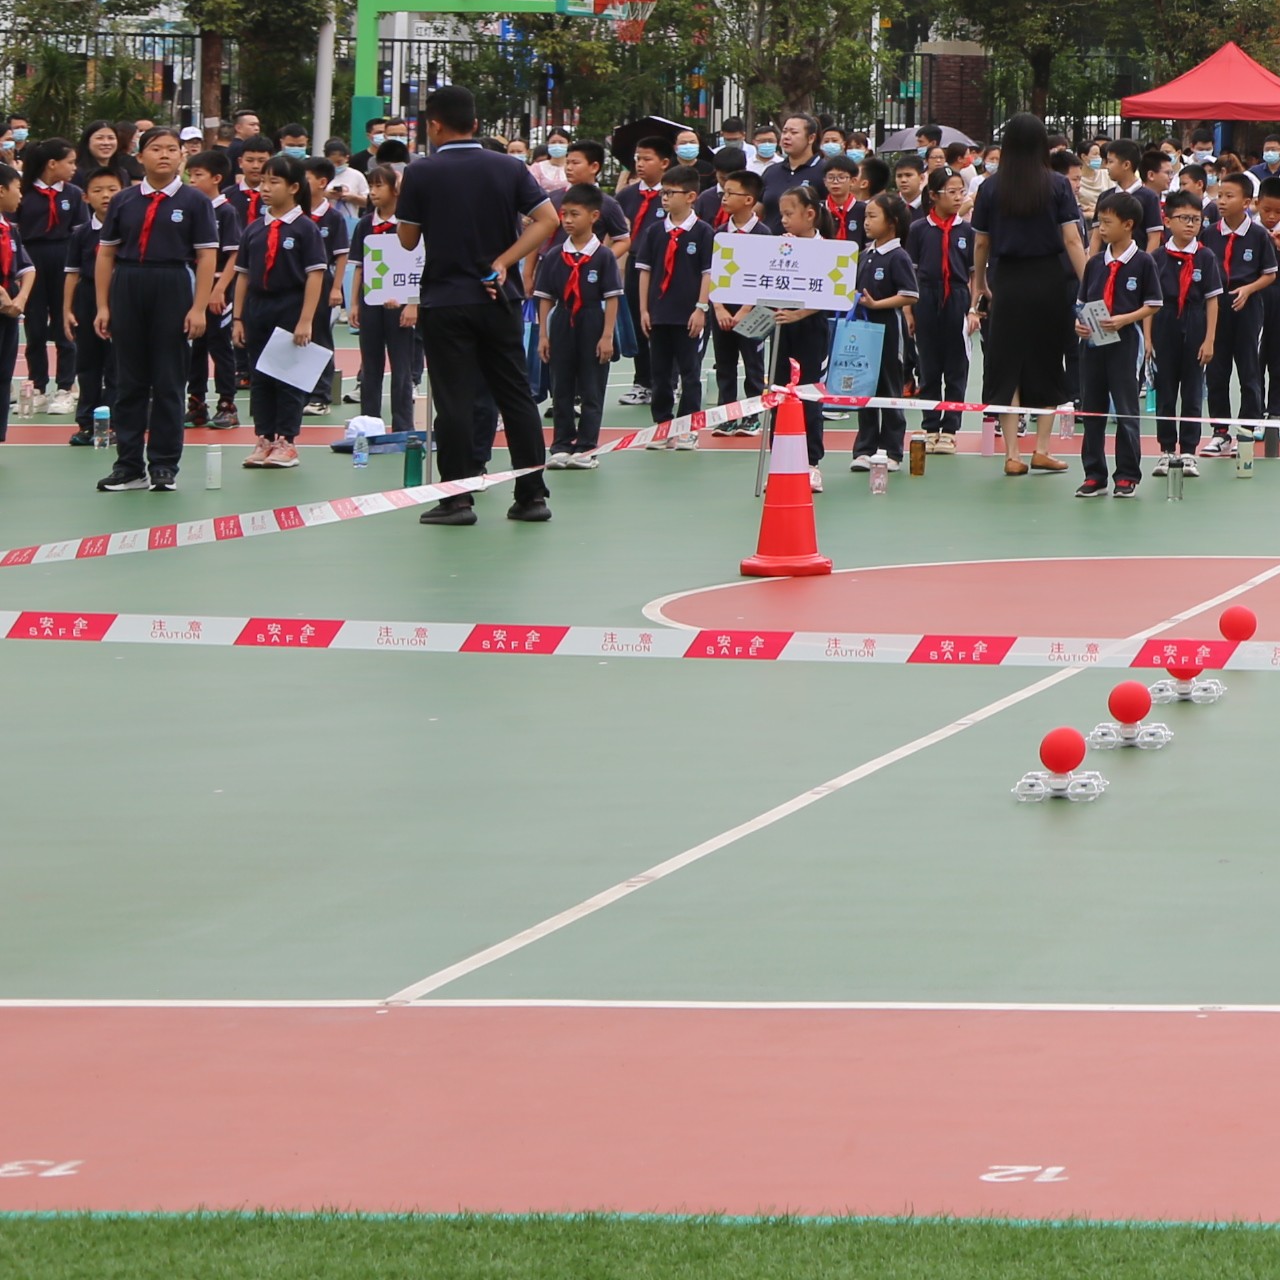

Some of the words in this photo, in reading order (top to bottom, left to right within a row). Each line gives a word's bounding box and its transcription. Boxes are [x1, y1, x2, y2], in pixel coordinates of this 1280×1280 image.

[742, 273, 823, 293] 三年级二班
[40, 616, 88, 630] 安全
[152, 620, 202, 632] 注意
[29, 627, 81, 637] SAFE
[150, 630, 200, 639] CAUTION
[267, 623, 315, 637] 安全
[379, 626, 428, 639] 注意
[493, 629, 540, 643] 安全
[257, 633, 308, 644] SAFE
[377, 636, 426, 646] CAUTION
[603, 632, 653, 644] 注意
[717, 635, 765, 648] 安全
[827, 637, 876, 650] 注意
[482, 639, 534, 650] SAFE
[601, 642, 651, 652] CAUTION
[706, 645, 758, 656] SAFE
[940, 640, 988, 654] 安全
[1050, 642, 1100, 655] 注意
[1163, 644, 1211, 657] 安全
[825, 648, 874, 657] CAUTION
[930, 651, 981, 661] SAFE
[1048, 653, 1097, 662] CAUTION
[1153, 655, 1203, 665] SAFE
[979, 1165, 1069, 1182] 12
